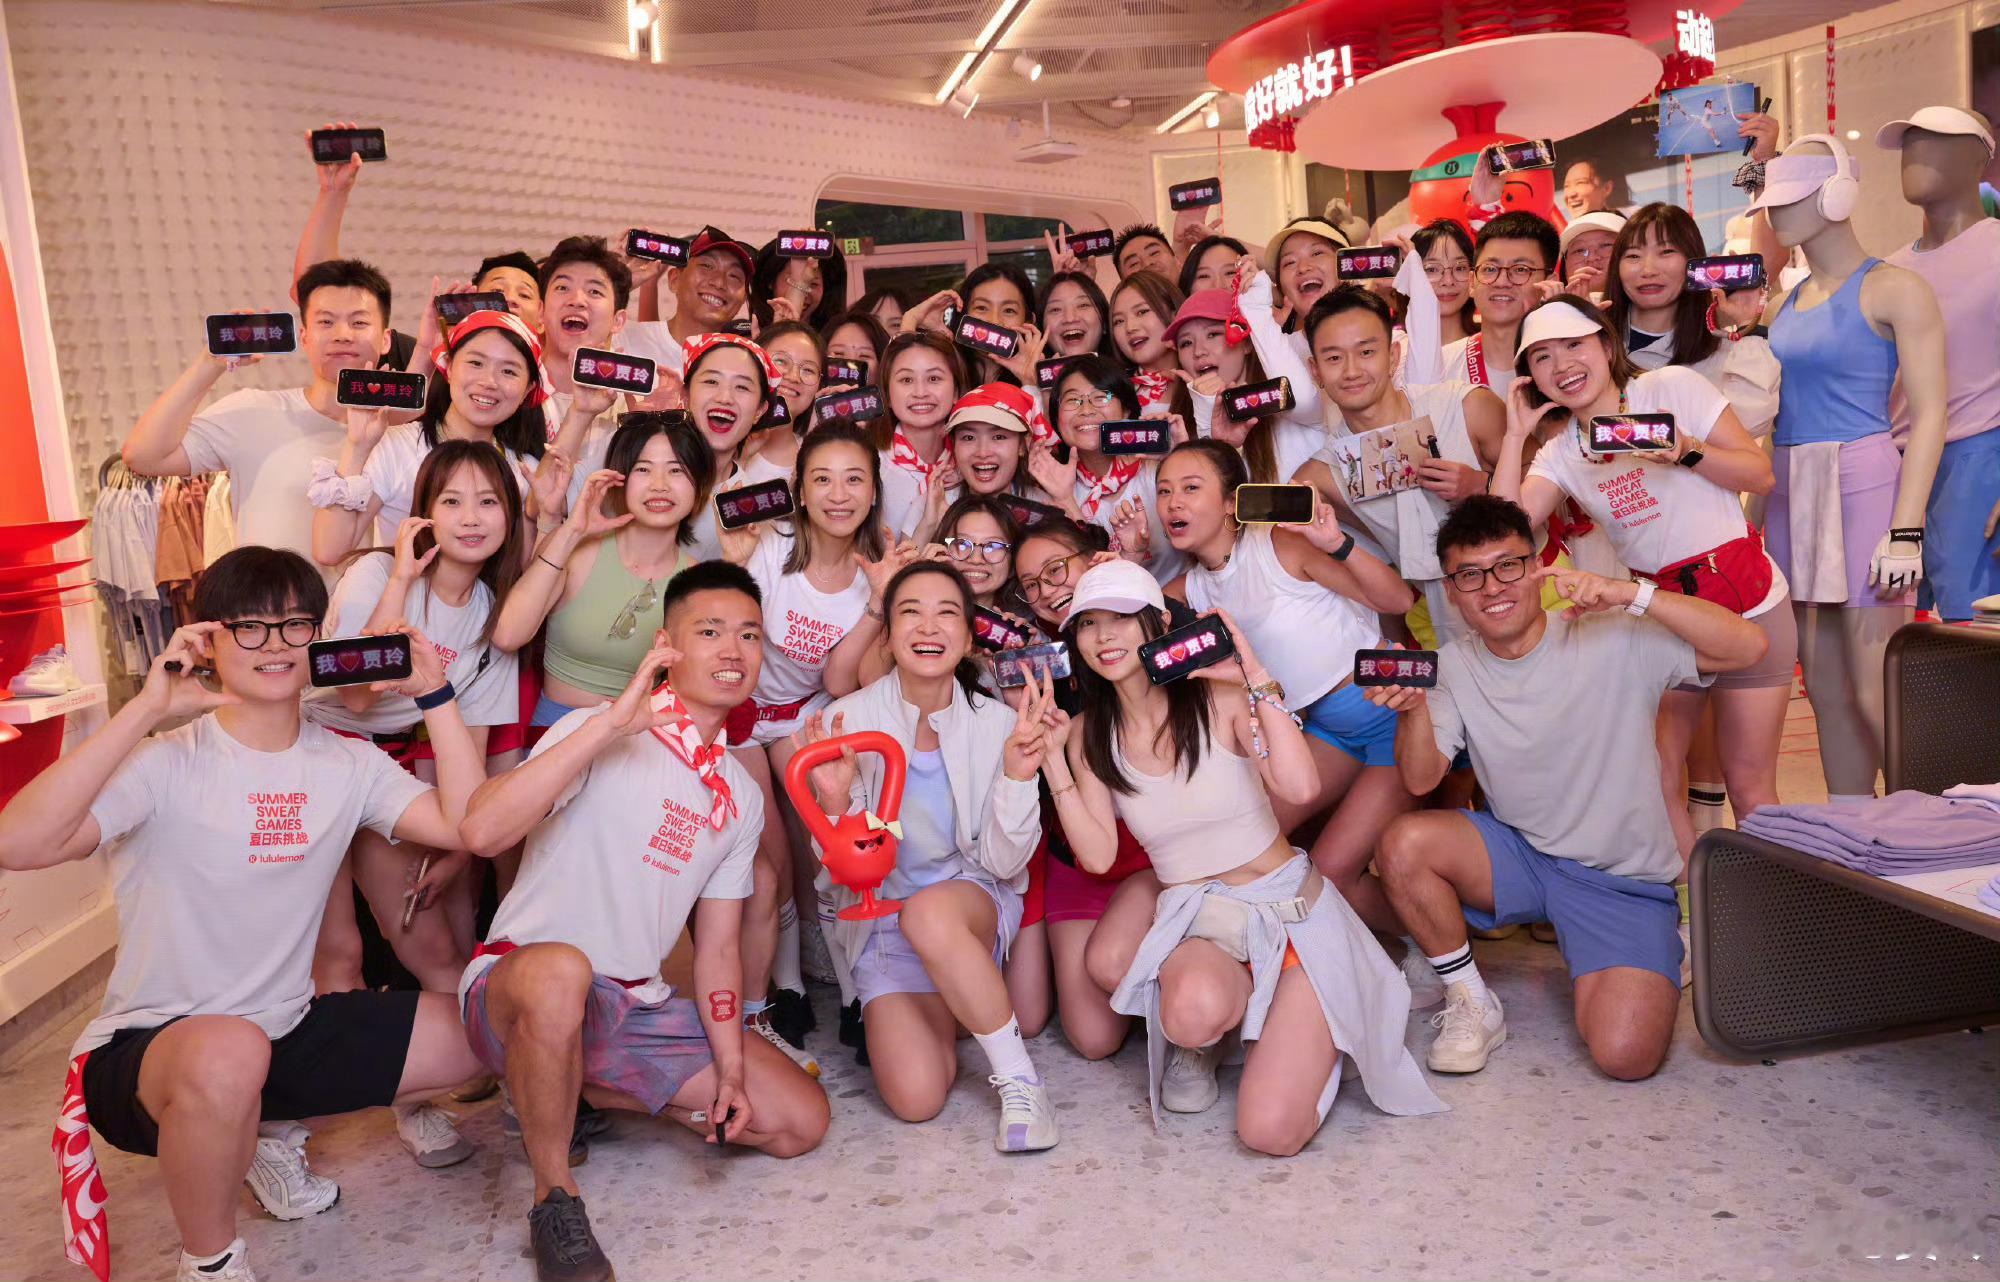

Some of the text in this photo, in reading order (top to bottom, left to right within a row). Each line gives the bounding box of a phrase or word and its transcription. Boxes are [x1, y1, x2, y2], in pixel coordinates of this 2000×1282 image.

[1598, 468, 1645, 493] SUMMER
[1607, 479, 1642, 500] SWEAT
[1610, 488, 1648, 509] GAMES
[786, 610, 843, 637] SUMMER
[789, 624, 834, 648] SWEAT
[247, 793, 308, 805] SUMMER
[256, 805, 302, 818] SWEAT
[662, 798, 708, 828] SUMMER
[255, 818, 302, 831] GAMES
[664, 813, 700, 837] SWEAT
[249, 832, 309, 847] 夏日乐挑战
[658, 825, 695, 849] GAMES
[260, 854, 305, 863] lululemon
